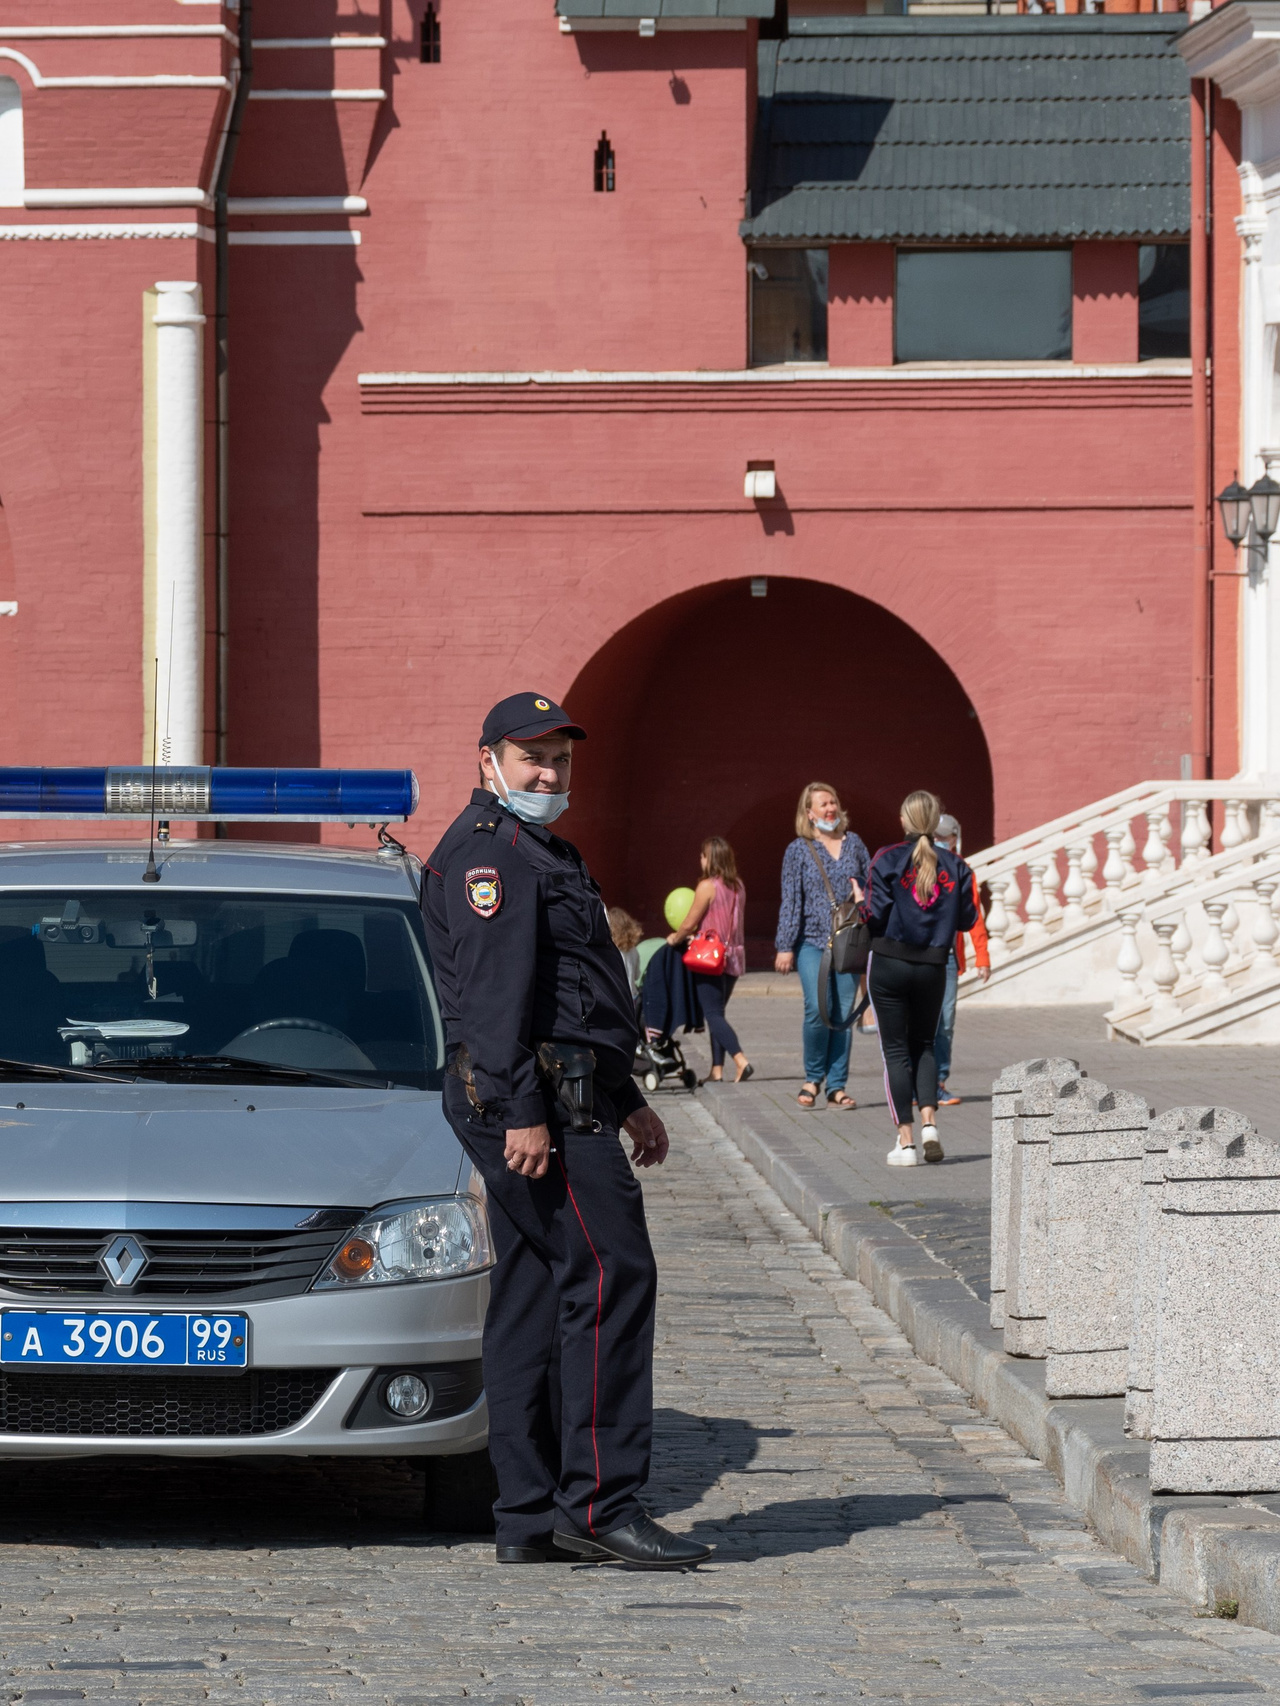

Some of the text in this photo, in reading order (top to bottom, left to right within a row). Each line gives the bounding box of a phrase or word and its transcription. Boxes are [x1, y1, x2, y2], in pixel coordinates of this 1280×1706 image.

[468, 869, 496, 877] ПОЛИЦИЯ
[900, 866, 956, 893] ESCDA
[62, 1319, 165, 1359] 3906
[192, 1318, 232, 1349] 99
[197, 1350, 226, 1362] RUS
